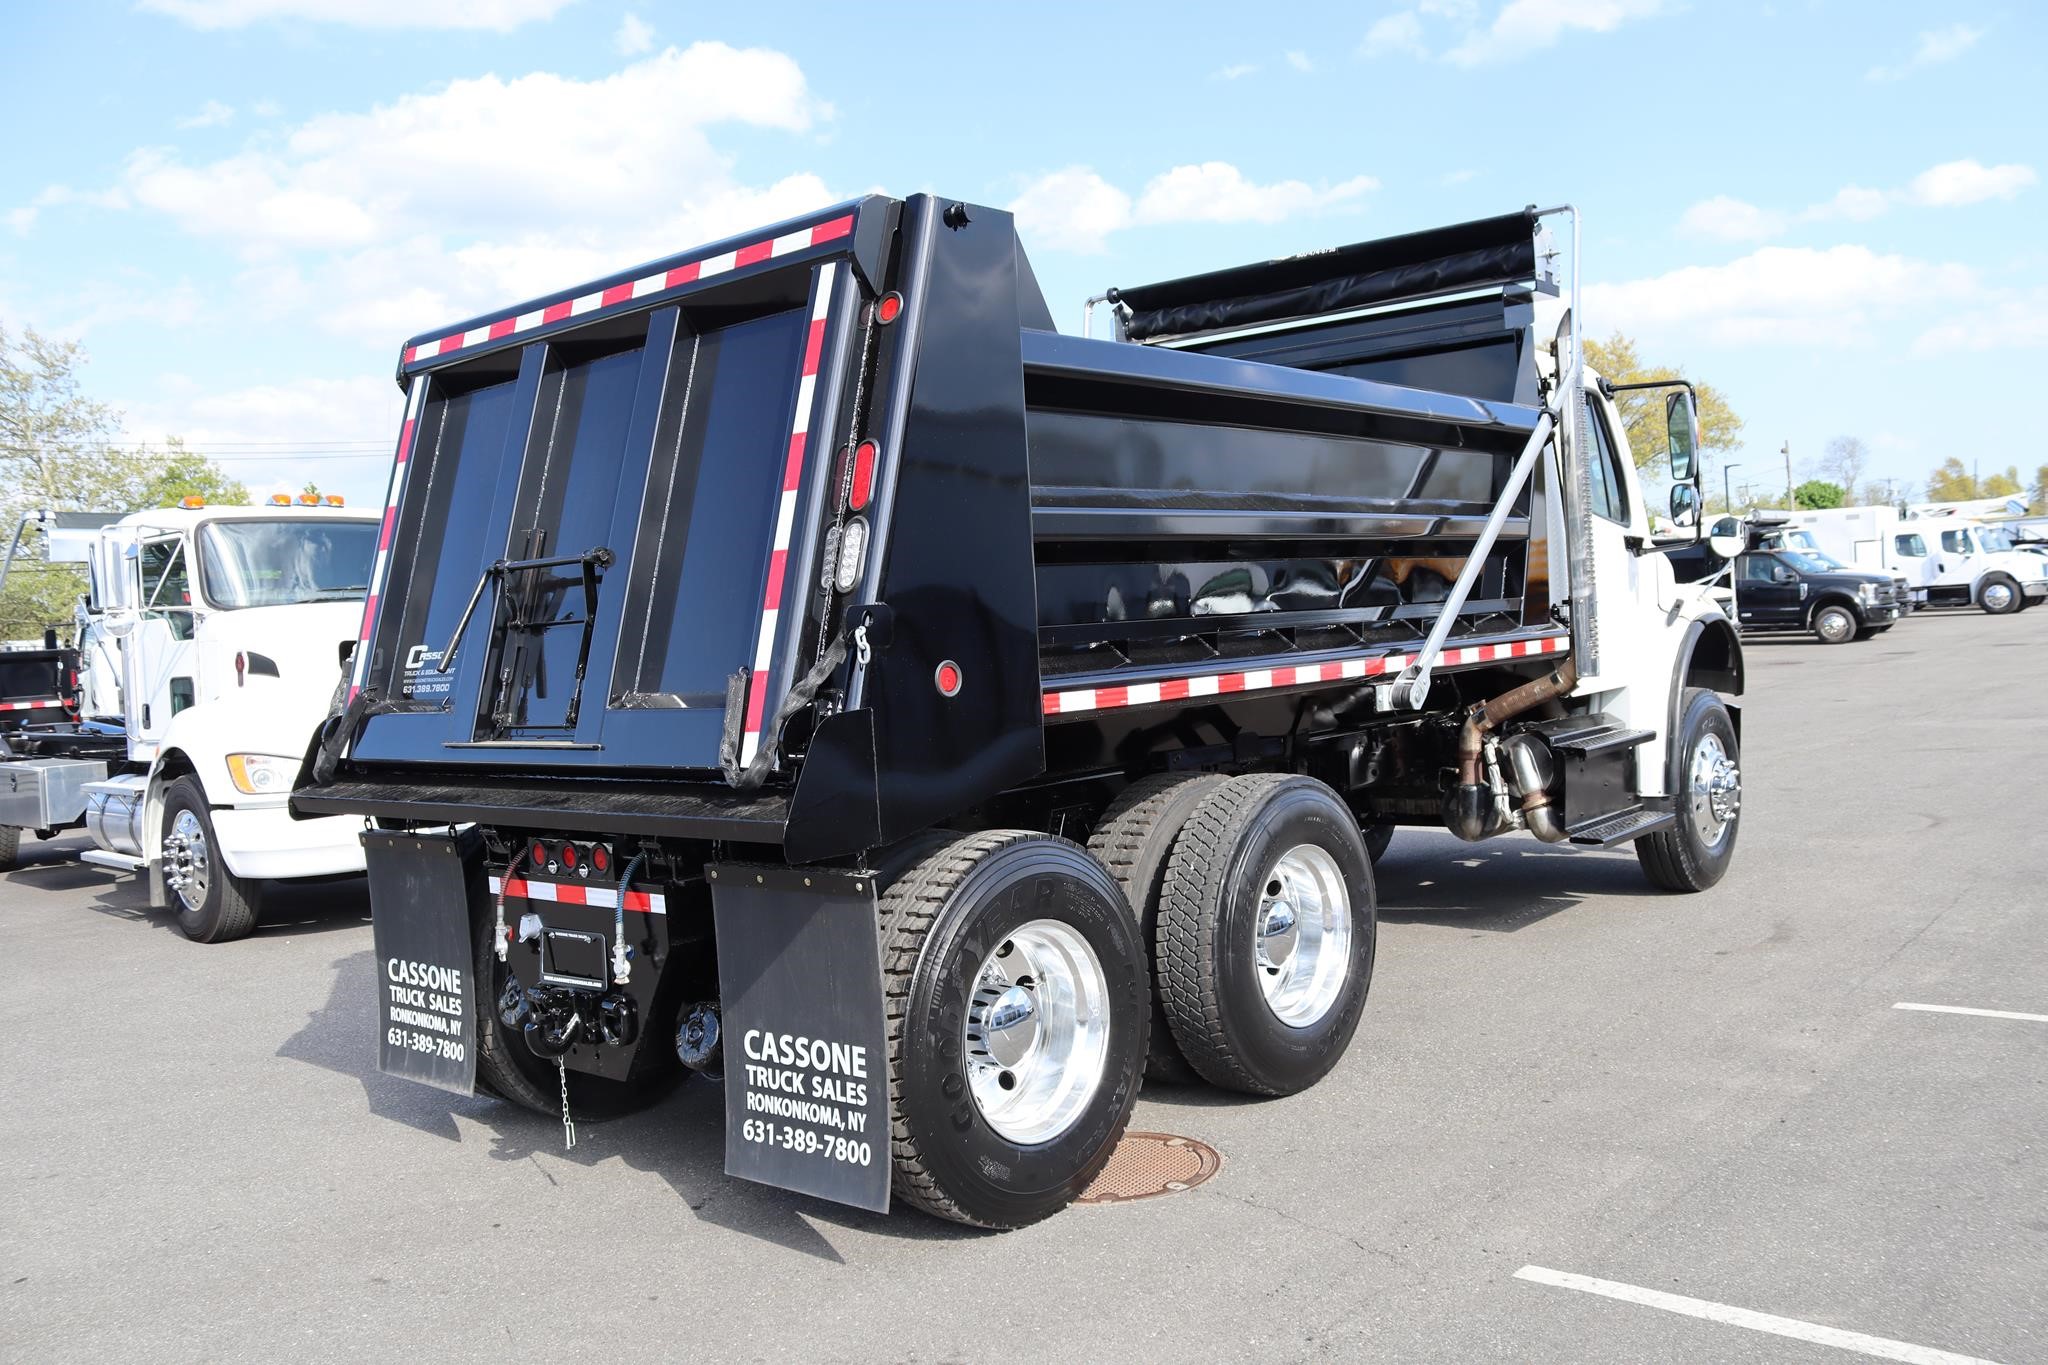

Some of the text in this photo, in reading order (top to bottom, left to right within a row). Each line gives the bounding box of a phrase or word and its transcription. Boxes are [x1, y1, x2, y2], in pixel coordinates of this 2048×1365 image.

[403, 683, 450, 694] 631.389.7800
[388, 958, 462, 995] CASSONE
[389, 985, 462, 1016] TRUCK SALES
[390, 1006, 462, 1036] RONKONKOMA, NY
[388, 1027, 464, 1062] 631-389-7800
[743, 1029, 868, 1079] CASSONE
[745, 1064, 868, 1106] TRUCK SALES
[746, 1091, 867, 1132] RONKONKOMA, NY
[742, 1118, 872, 1167] 631-389-7800
